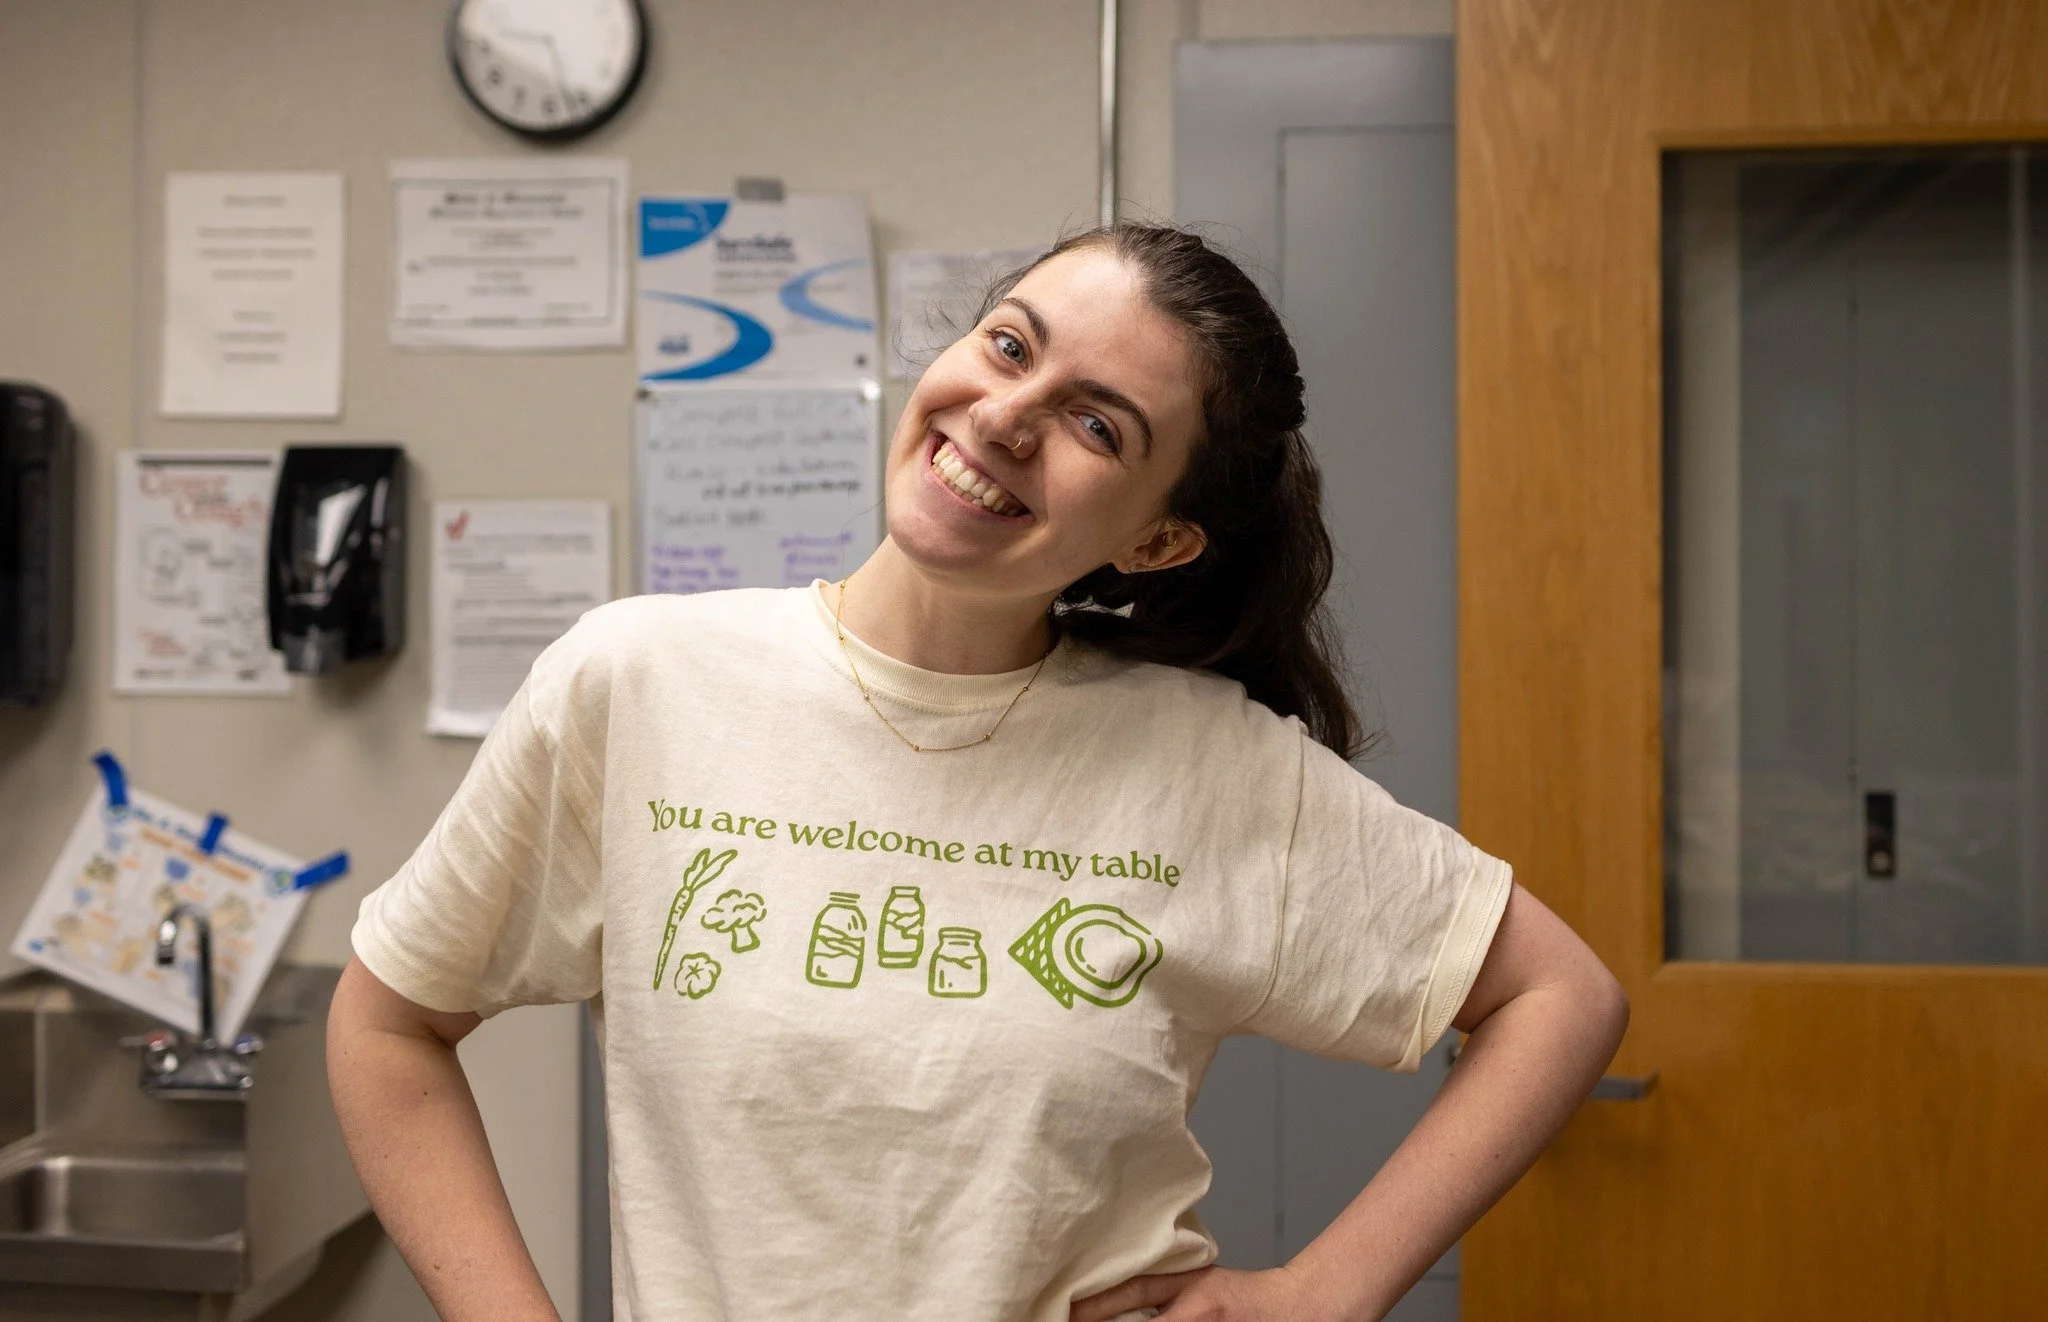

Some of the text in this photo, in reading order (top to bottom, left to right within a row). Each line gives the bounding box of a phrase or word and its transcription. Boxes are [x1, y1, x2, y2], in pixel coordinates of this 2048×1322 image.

[648, 799, 1182, 888] You are welcome at my table
